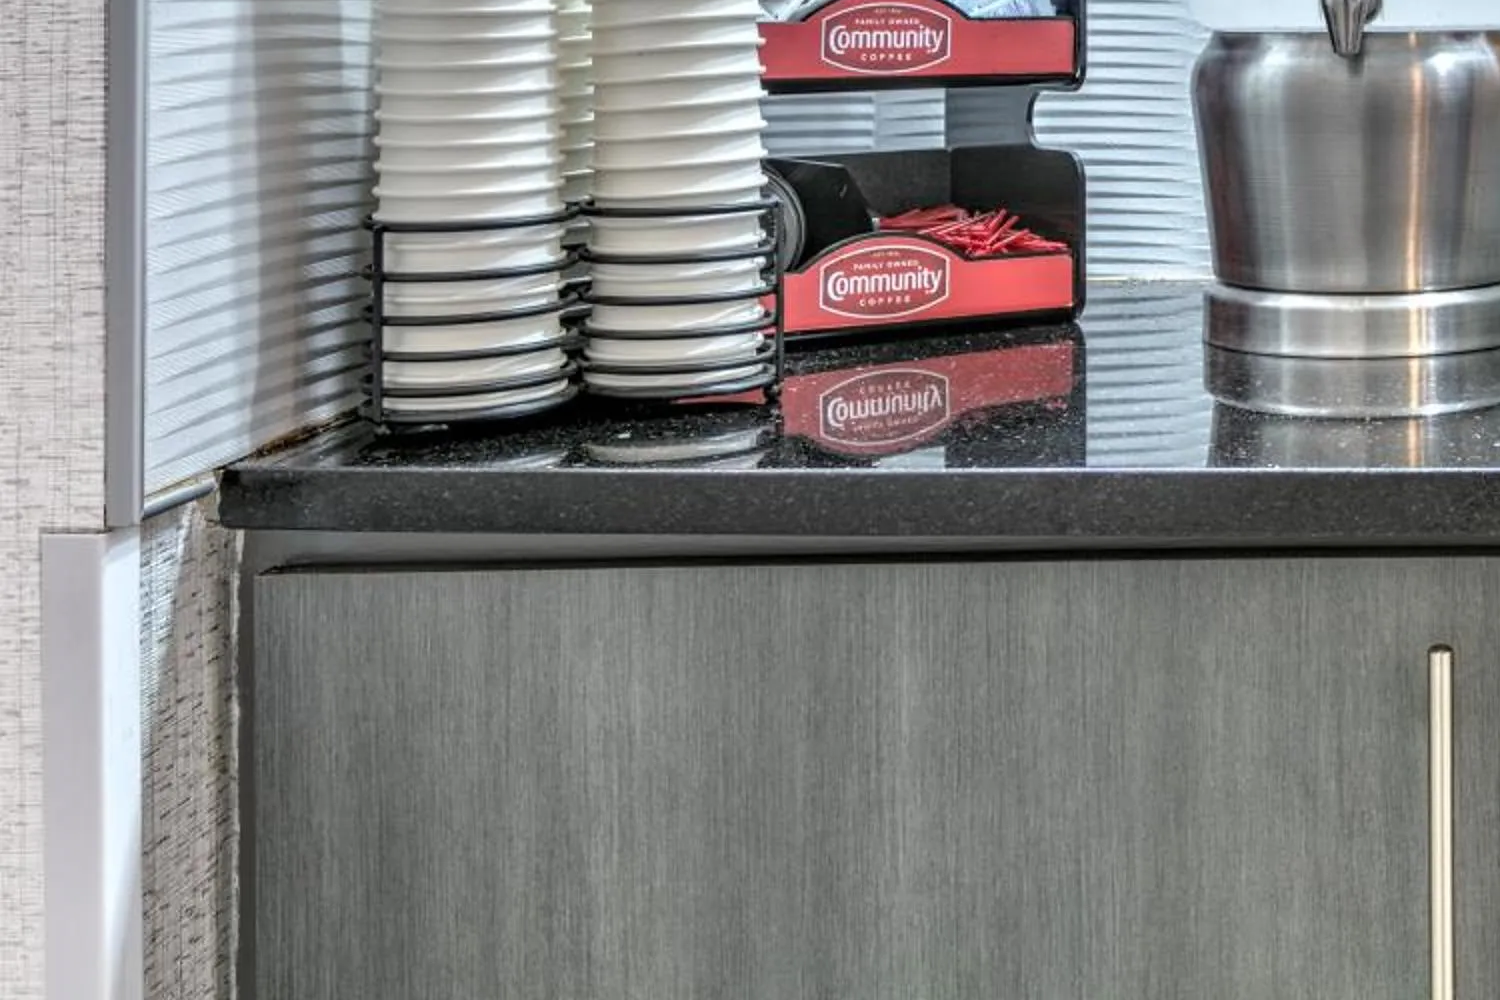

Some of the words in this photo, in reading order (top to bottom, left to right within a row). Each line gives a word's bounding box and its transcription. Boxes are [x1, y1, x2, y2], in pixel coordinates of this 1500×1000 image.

[829, 25, 944, 55] Community
[860, 53, 913, 62] COFFEE
[827, 266, 943, 301] Community
[859, 295, 911, 307] COFFEE
